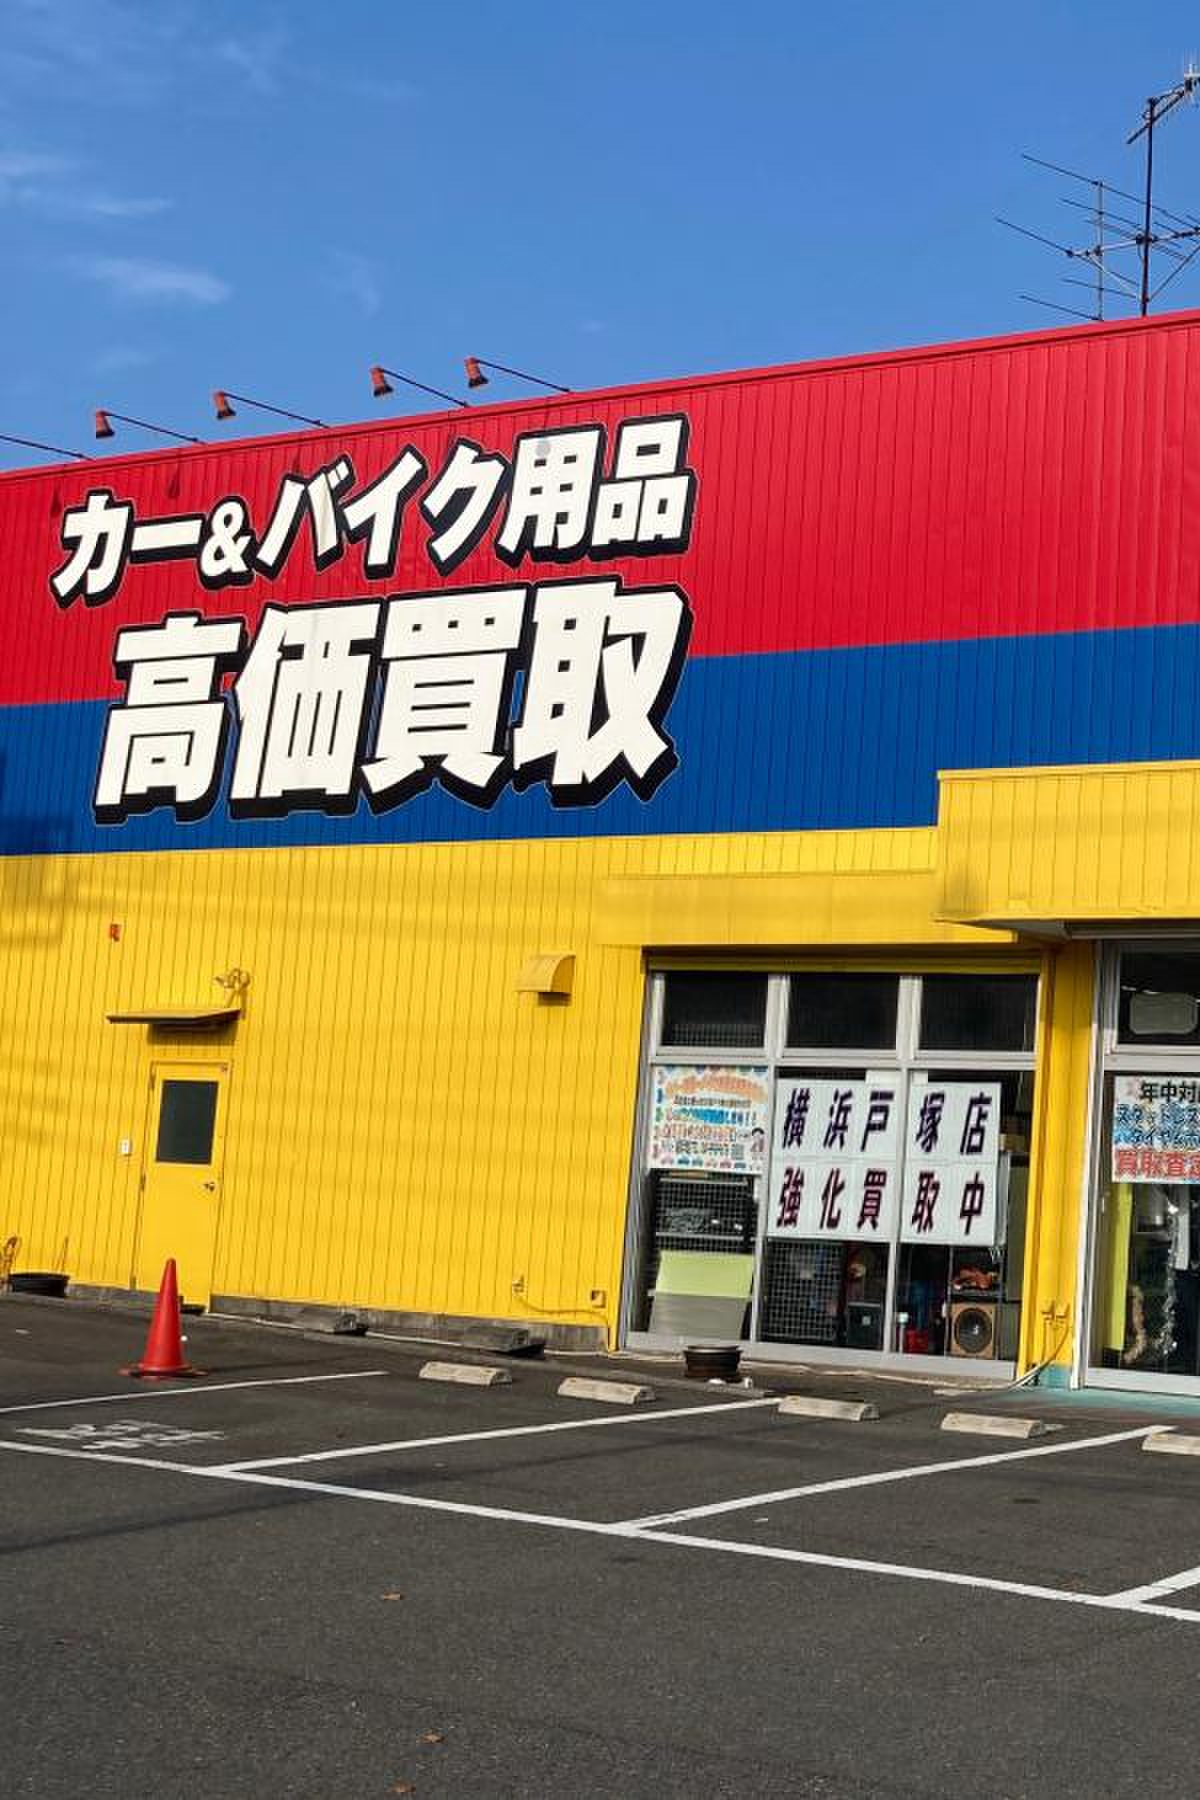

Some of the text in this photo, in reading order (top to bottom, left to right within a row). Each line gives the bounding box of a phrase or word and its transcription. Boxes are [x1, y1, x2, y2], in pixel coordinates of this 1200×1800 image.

[51, 416, 695, 603] カー&バイク用品
[94, 578, 688, 815] 高価買取
[781, 1086, 993, 1157] 横浜戸塚店
[776, 1166, 986, 1237] 強化買取中
